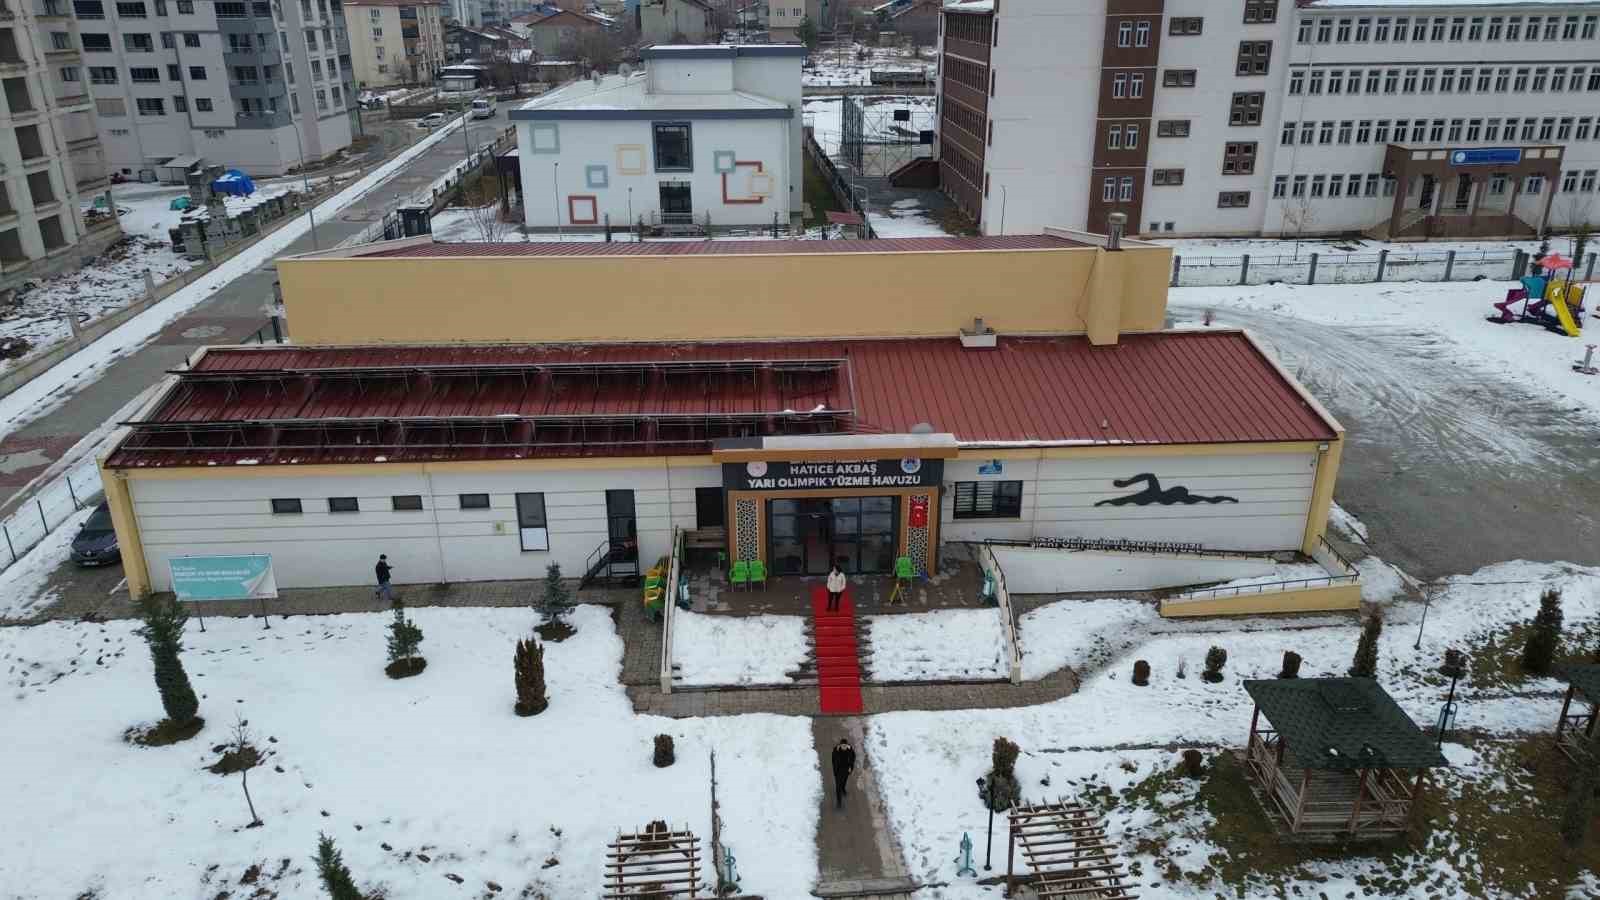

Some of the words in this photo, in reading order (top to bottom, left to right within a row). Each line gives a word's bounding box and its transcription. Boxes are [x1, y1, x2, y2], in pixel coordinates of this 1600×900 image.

[835, 463, 877, 475] AKBAŞ
[747, 477, 776, 489] YARI
[829, 474, 871, 487] YÜZME
[872, 474, 921, 486] HAVUZU
